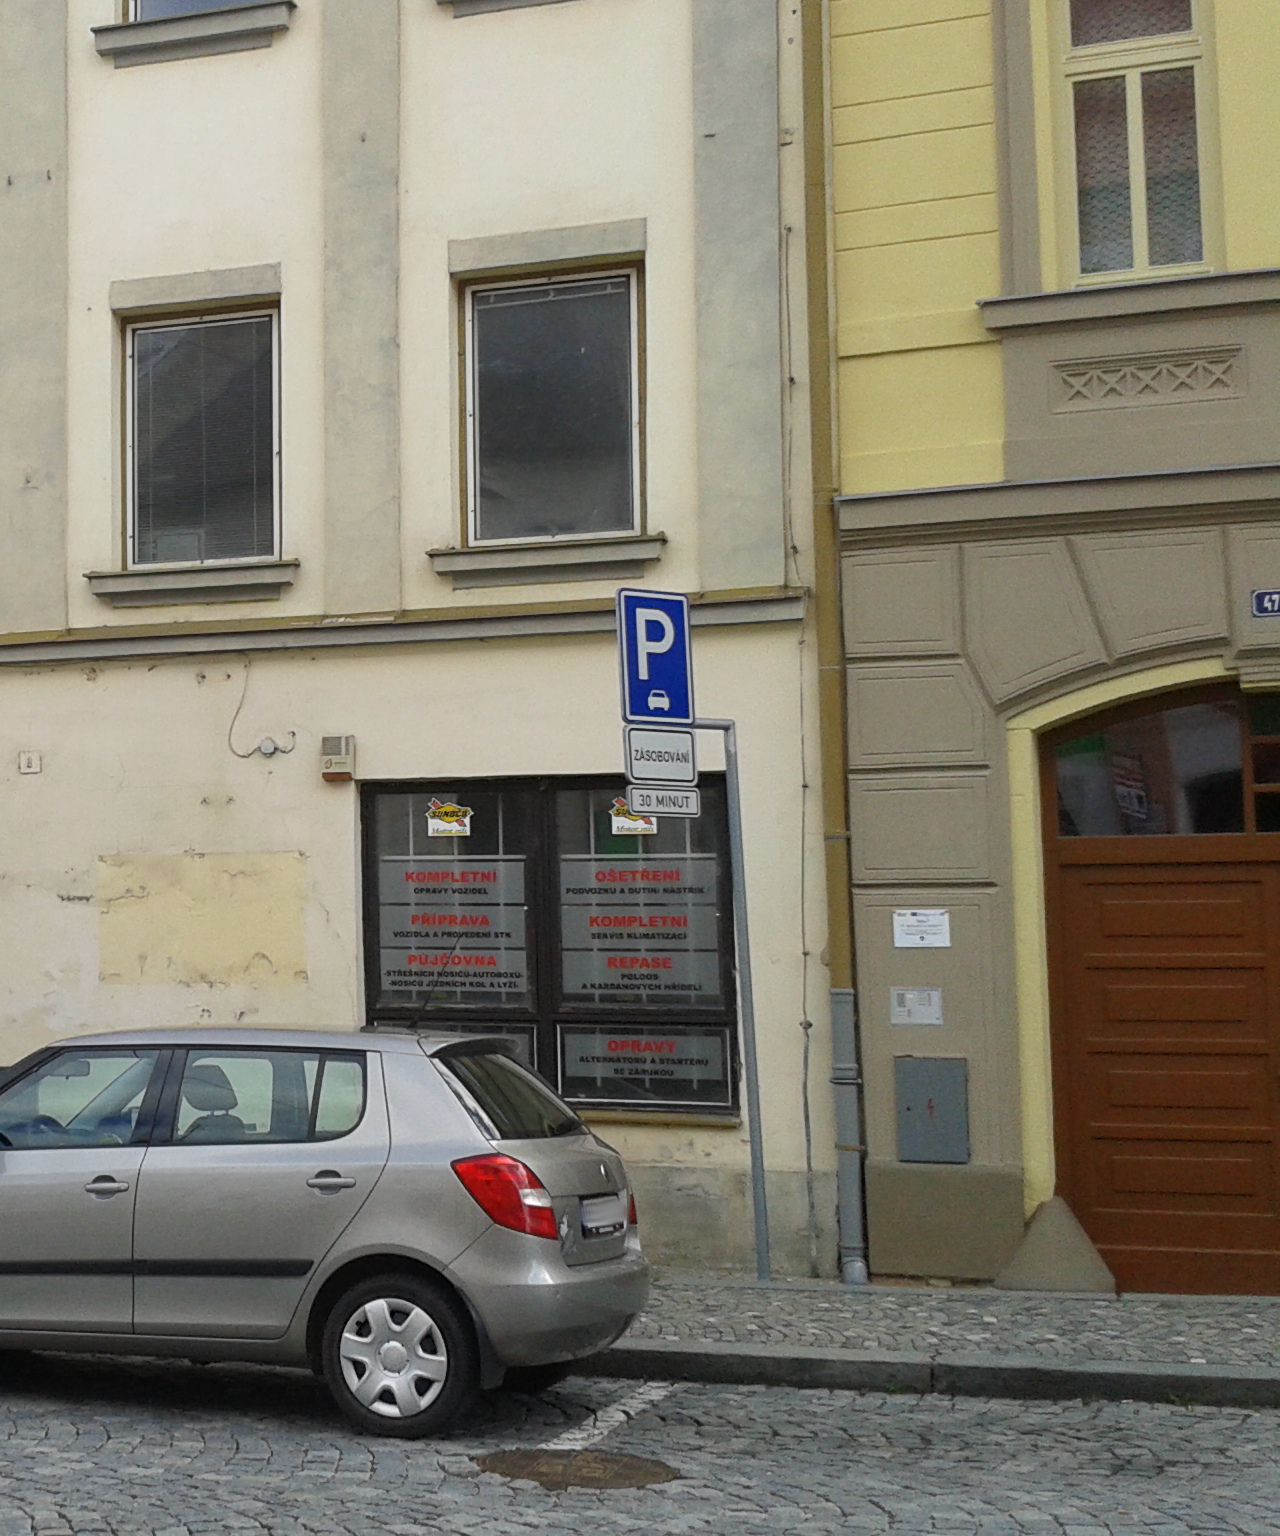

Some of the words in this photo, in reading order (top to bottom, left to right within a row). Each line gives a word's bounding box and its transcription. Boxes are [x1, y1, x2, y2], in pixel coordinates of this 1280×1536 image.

[1263, 594, 1280, 611] 47
[635, 607, 675, 680] P
[639, 793, 652, 807] 30
[656, 794, 690, 809] MINUT
[405, 870, 497, 883] KOMPLETNÍ
[595, 868, 681, 882] OŠETŘENÍ
[413, 887, 448, 895] OPRAVY
[451, 887, 489, 895] VOZIDEL
[619, 887, 626, 895] A
[411, 912, 491, 927] PŘÍPRAVA
[588, 914, 689, 928] KOMPLETNÍ
[441, 930, 491, 938] PROVEDENÍ
[591, 932, 624, 940] SERVIS
[407, 952, 497, 966] PŮJČOVNA
[607, 956, 672, 969] REPASE
[607, 1039, 677, 1053] OPRAVY
[650, 1056, 656, 1064] A
